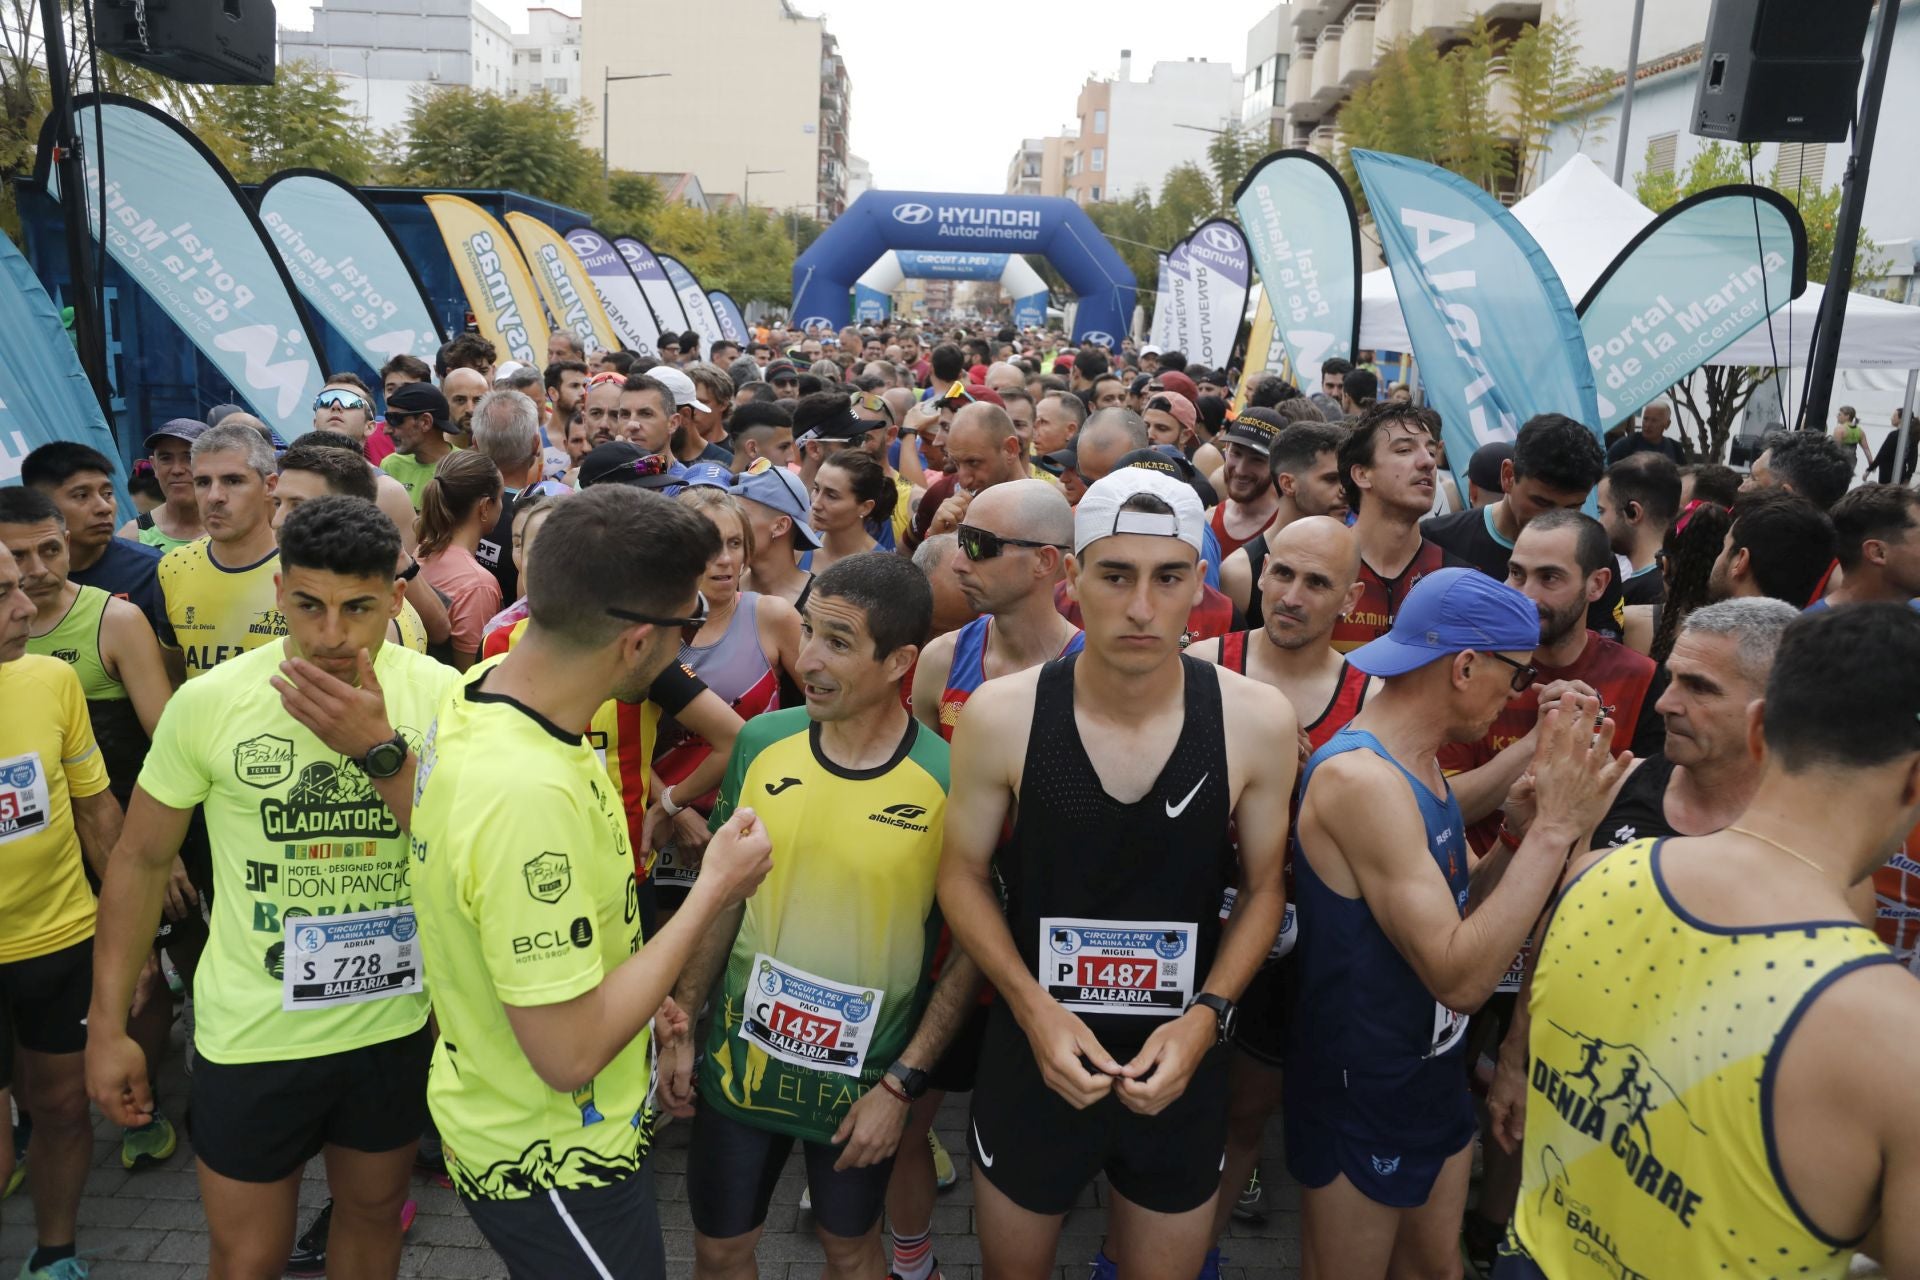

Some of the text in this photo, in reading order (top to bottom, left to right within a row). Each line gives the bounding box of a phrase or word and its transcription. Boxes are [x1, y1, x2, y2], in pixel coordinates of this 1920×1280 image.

[938, 207, 1041, 227] HYUNDAI
[938, 223, 1039, 240] Autoalmenar
[917, 255, 990, 265] CIRCUIT A PEU
[1606, 251, 1787, 390] de la Marina
[1586, 294, 1676, 371] Portal
[288, 865, 321, 876] HOTEL
[329, 863, 374, 874] DESIGNED
[376, 861, 392, 871] FOR
[288, 876, 335, 898] DON
[327, 924, 362, 935] CIRCUIT
[372, 920, 391, 929] PEU
[333, 928, 386, 941] MARINA ALTA
[1083, 931, 1153, 941] CIRCUIT A PEU
[512, 930, 569, 954] BCL
[1089, 939, 1148, 948] MARINA ALTA
[1101, 948, 1136, 957] MIGUEL
[303, 953, 381, 981] S 728
[516, 954, 543, 965] HOTEL
[1058, 962, 1155, 988] P 1487
[784, 978, 816, 997] CIRCUIT
[826, 990, 843, 1002] PEU
[787, 987, 815, 1002] MARINA
[817, 997, 837, 1009] ALTA
[799, 1001, 820, 1013] PACO
[756, 1003, 837, 1045] C 1457
[778, 1074, 806, 1104] EL
[1611, 1122, 1703, 1229] CORRE
